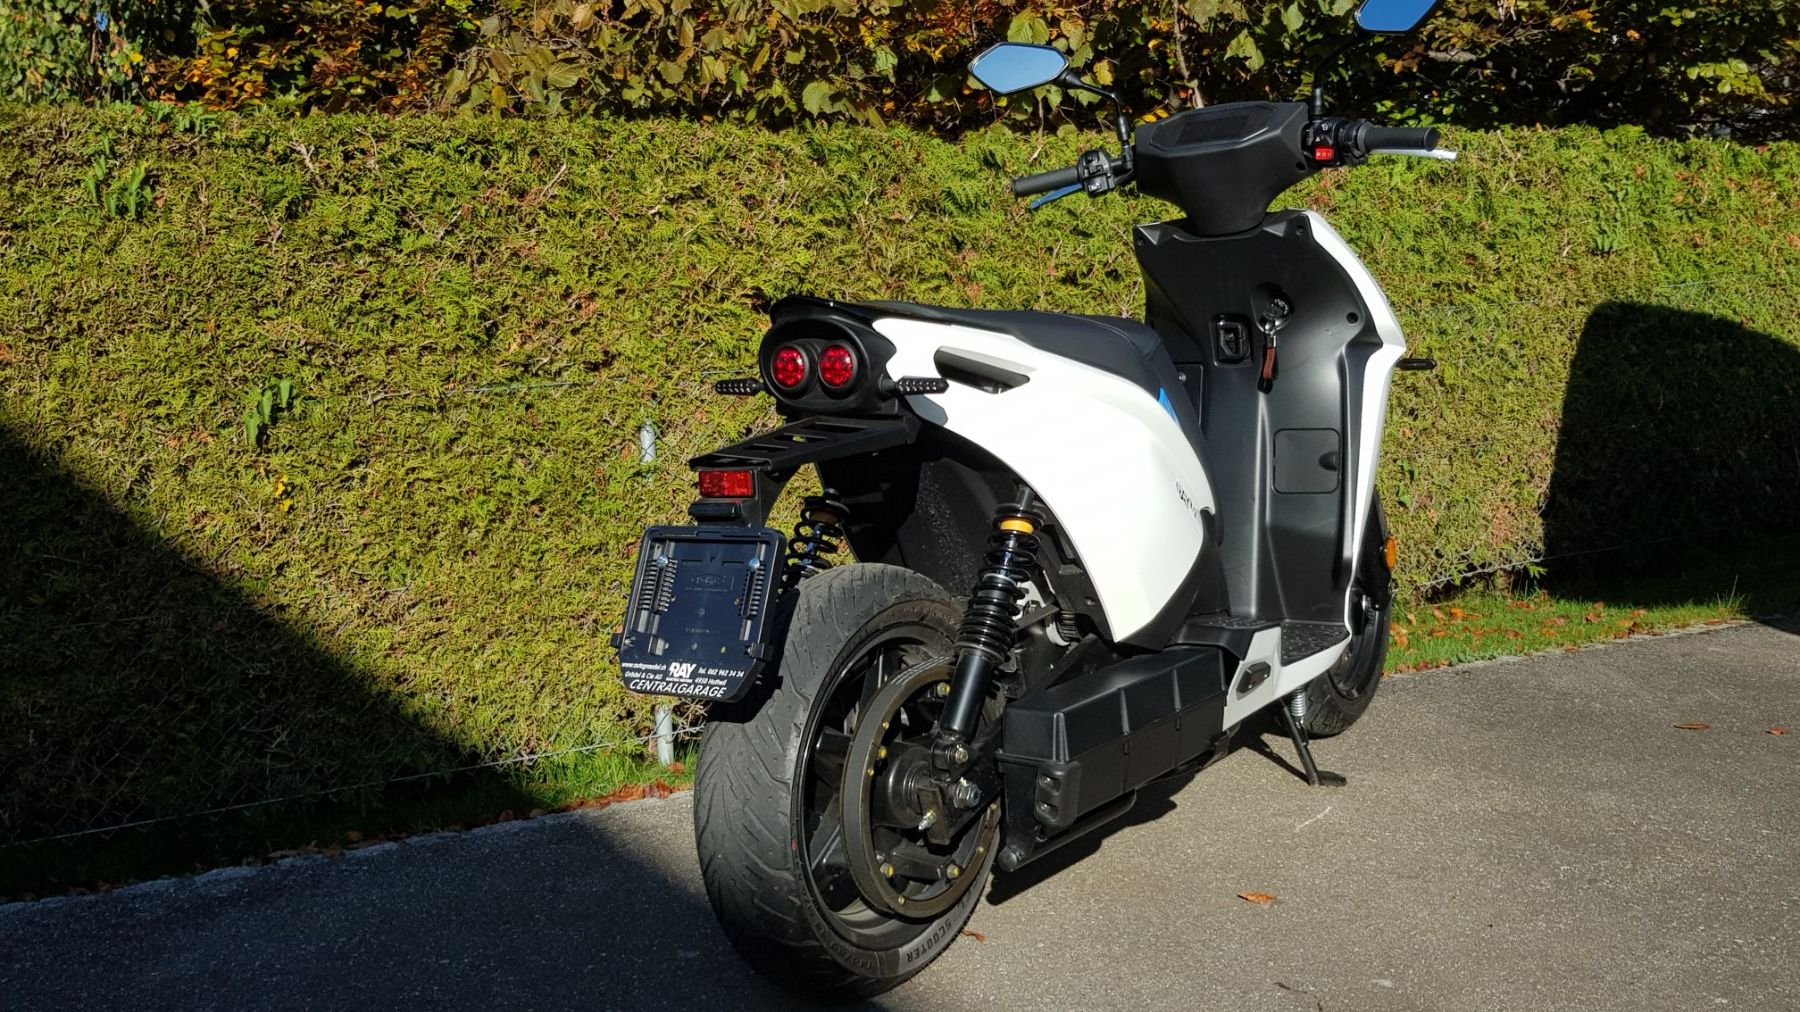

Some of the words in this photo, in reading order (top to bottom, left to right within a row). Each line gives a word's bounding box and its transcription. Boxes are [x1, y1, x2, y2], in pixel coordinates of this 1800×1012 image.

[669, 662, 697, 678] RAY
[629, 679, 727, 698] CENTRALGARAGE
[906, 918, 952, 963] SCOOTER
